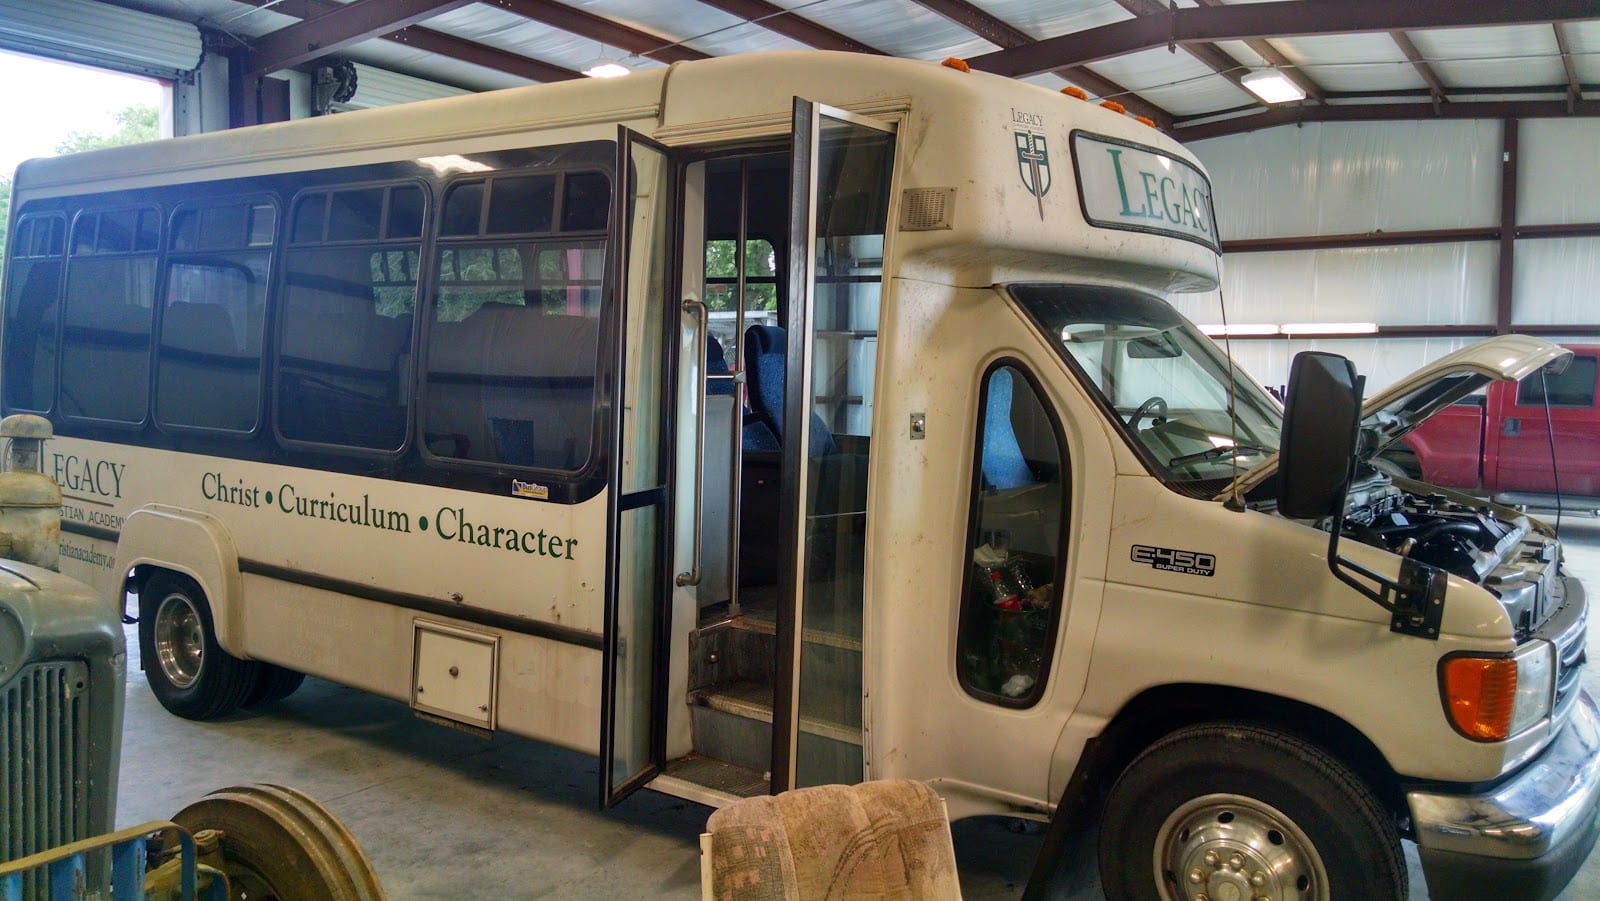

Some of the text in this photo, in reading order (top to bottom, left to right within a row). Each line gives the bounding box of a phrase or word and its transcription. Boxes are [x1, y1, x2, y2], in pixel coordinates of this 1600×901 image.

[1009, 107, 1044, 127] LEGACY
[58, 505, 84, 521] STIAN
[201, 472, 578, 560] Christ Curriculum Character
[1131, 545, 1215, 571] E-450
[1156, 563, 1211, 576] SUPER DUTY
